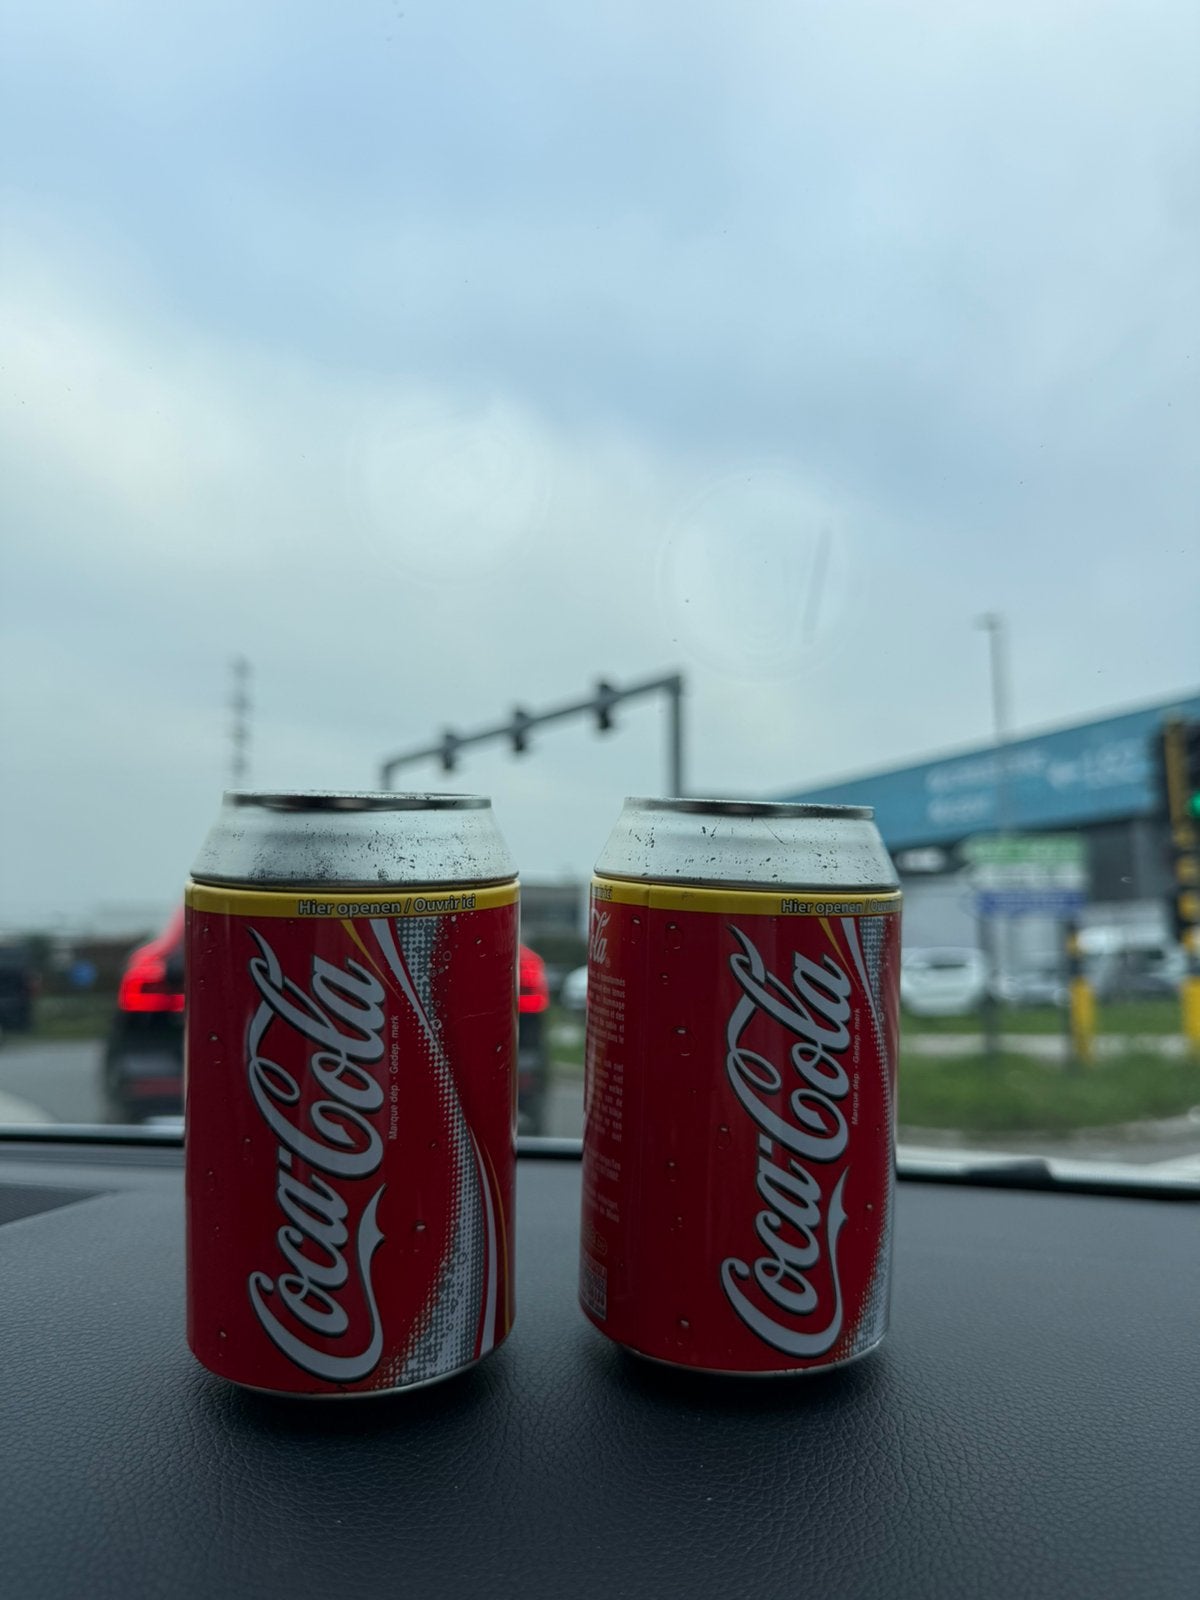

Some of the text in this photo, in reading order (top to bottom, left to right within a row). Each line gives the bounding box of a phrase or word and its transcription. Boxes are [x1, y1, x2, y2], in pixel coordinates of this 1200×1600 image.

[298, 900, 333, 915] Hier
[337, 902, 401, 917] openen
[414, 895, 459, 912] Ouvrir
[462, 893, 476, 909] ici
[781, 899, 813, 914] Hier
[816, 901, 863, 917] openen
